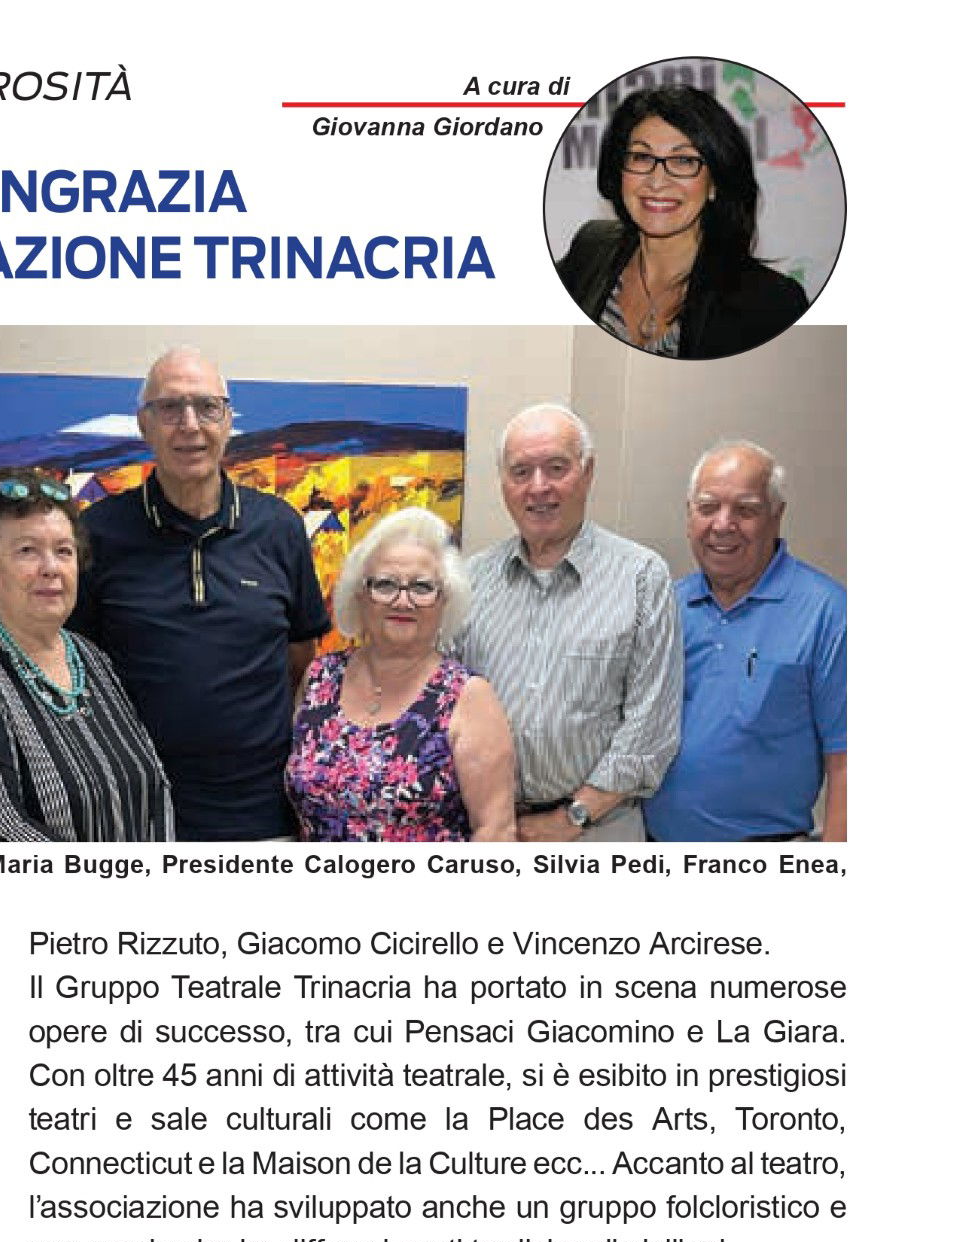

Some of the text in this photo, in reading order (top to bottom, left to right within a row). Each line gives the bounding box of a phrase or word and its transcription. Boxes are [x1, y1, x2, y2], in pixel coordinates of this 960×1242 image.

[462, 76, 572, 96] A cura di
[312, 116, 544, 137] Giovanna Giordano
[193, 235, 496, 280] TRINACRIA
[64, 854, 151, 879] Bugge,
[162, 854, 294, 874] Presidente
[304, 854, 416, 879] Calogero
[427, 854, 521, 878] Caruso,
[533, 854, 600, 874] Silvia
[611, 854, 671, 878] Pedi,
[683, 854, 767, 874] Franco
[779, 854, 846, 878] Enea,
[30, 931, 770, 960] Pietro Rizzuto, Giacomo Cicirello e Vincenzo Arcirese.
[30, 974, 847, 1005] Il Gruppo Teatrale Trinacria ha portato in scena numerose
